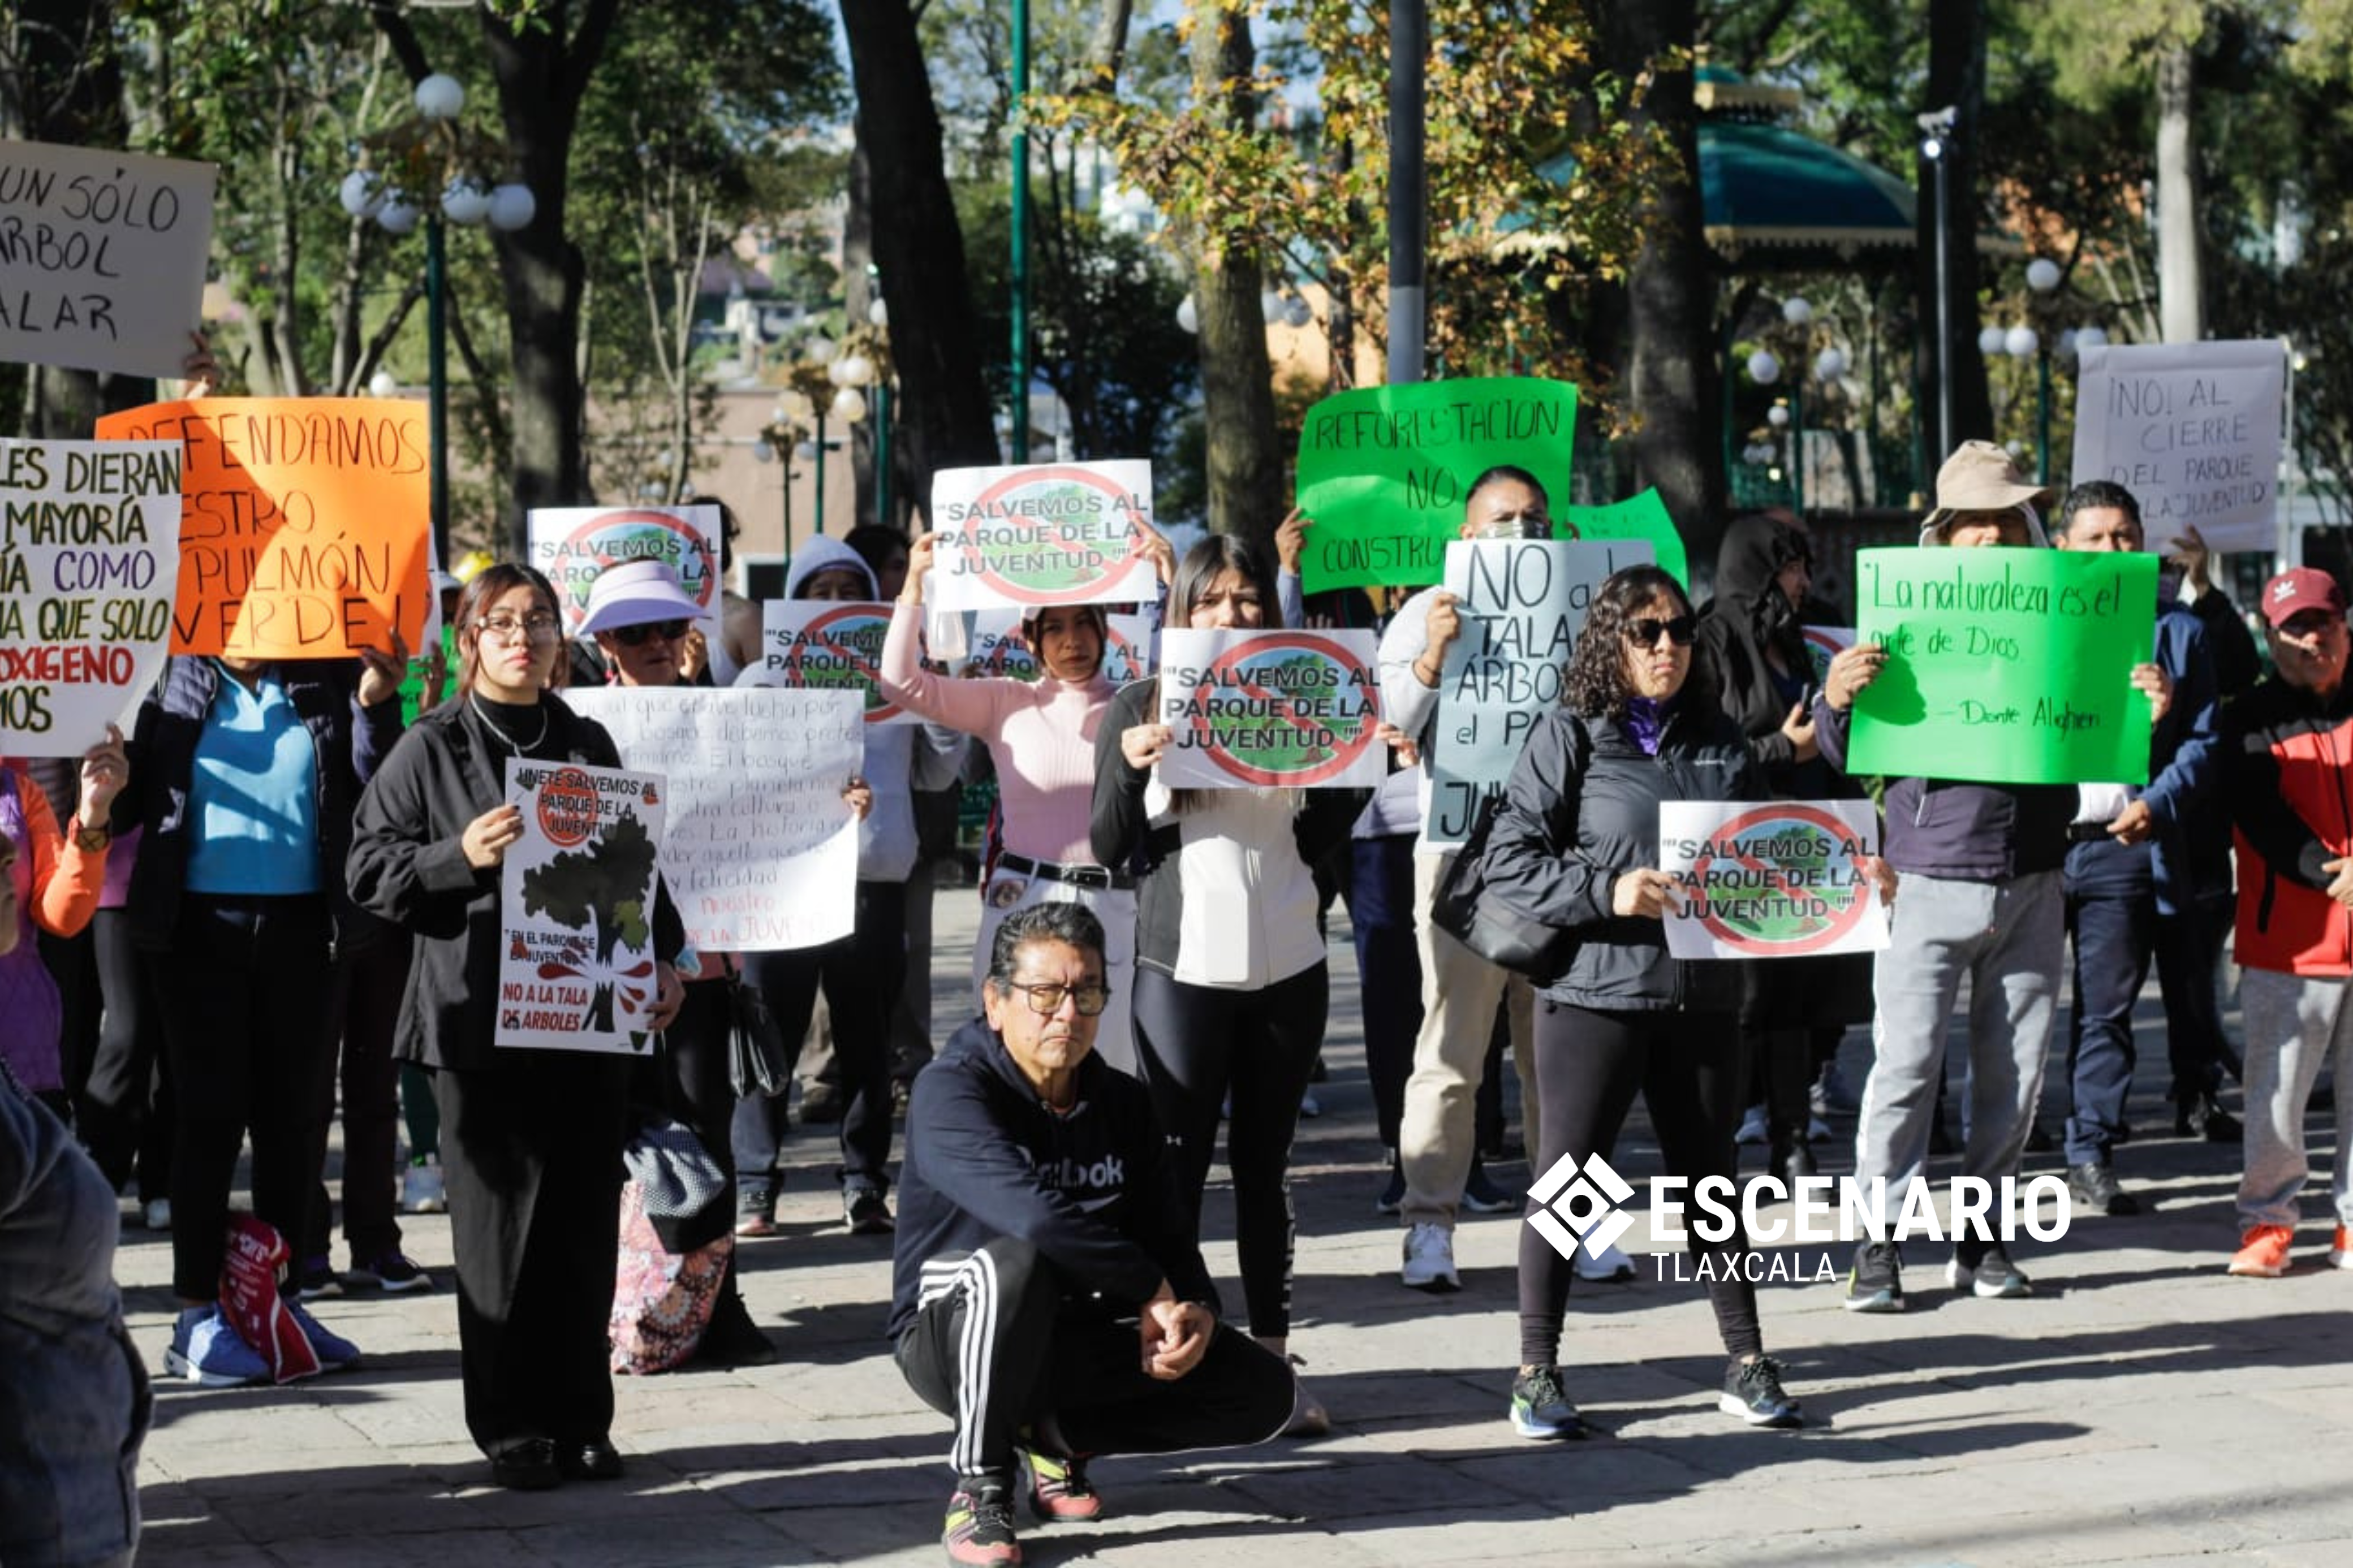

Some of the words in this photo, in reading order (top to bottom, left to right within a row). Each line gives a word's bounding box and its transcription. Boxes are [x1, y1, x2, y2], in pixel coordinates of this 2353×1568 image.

[0, 166, 55, 208] UN
[62, 167, 179, 232] SÓLO
[2188, 379, 2232, 408] AL
[2140, 413, 2249, 452] CIERRE
[65, 448, 180, 496] DIERAN
[2110, 464, 2165, 487] DEL
[2184, 454, 2253, 482] PARQUE
[1407, 466, 1457, 509] NO
[1112, 493, 1148, 512] AL
[2144, 496, 2171, 519] LA
[6, 494, 148, 545] MAYORÍA
[689, 536, 717, 554] AL
[938, 526, 1051, 548] PARQUE
[1061, 523, 1097, 541] DE
[1105, 520, 1141, 539] LA
[184, 532, 390, 595] PULMÓN
[951, 550, 1103, 576] JUVENTUD
[1322, 535, 1446, 574] CONSTRU
[54, 549, 156, 593] COMO
[683, 564, 712, 580] LA
[1467, 543, 1552, 611] NO
[1923, 561, 2048, 613] naturaleza
[2059, 585, 2087, 615] es
[2095, 573, 2121, 616] el
[37, 597, 95, 642] QUE
[101, 597, 169, 642] SOLO
[1472, 614, 1573, 659] TALA
[1871, 623, 1915, 655] arte
[1928, 627, 1955, 654] de
[1964, 623, 2019, 660] Dios
[0, 644, 134, 686] OXIGENO
[768, 654, 860, 672] PARQUE
[1116, 645, 1145, 660] AL
[1107, 666, 1136, 681] LA
[1348, 667, 1380, 686] AL
[1166, 698, 1283, 720] PARQUE
[1294, 698, 1331, 718] DE
[1339, 697, 1375, 718] LA
[1177, 728, 1335, 749] JUVENTUD
[1456, 713, 1478, 746] el
[741, 748, 813, 777] bosque
[566, 773, 639, 795] SALVEMOS
[642, 781, 657, 798] AL
[540, 793, 593, 812] PARQUE
[596, 798, 613, 816] DE
[615, 801, 632, 818] LA
[549, 817, 617, 839] JUVENTU
[1840, 836, 1875, 857] AL
[690, 866, 778, 891] felicidad
[1666, 869, 1778, 889] PARQUE
[1787, 867, 1822, 888] DE
[1830, 866, 1866, 886] LA
[1677, 898, 1828, 919] JUVENTUD
[527, 930, 539, 945] EL
[503, 982, 522, 1002] NO
[525, 984, 535, 1002] A
[539, 986, 554, 1004] LA
[557, 987, 588, 1005] TALA
[522, 1008, 580, 1032] ARBOLES
[1016, 1144, 1124, 1187] bok
